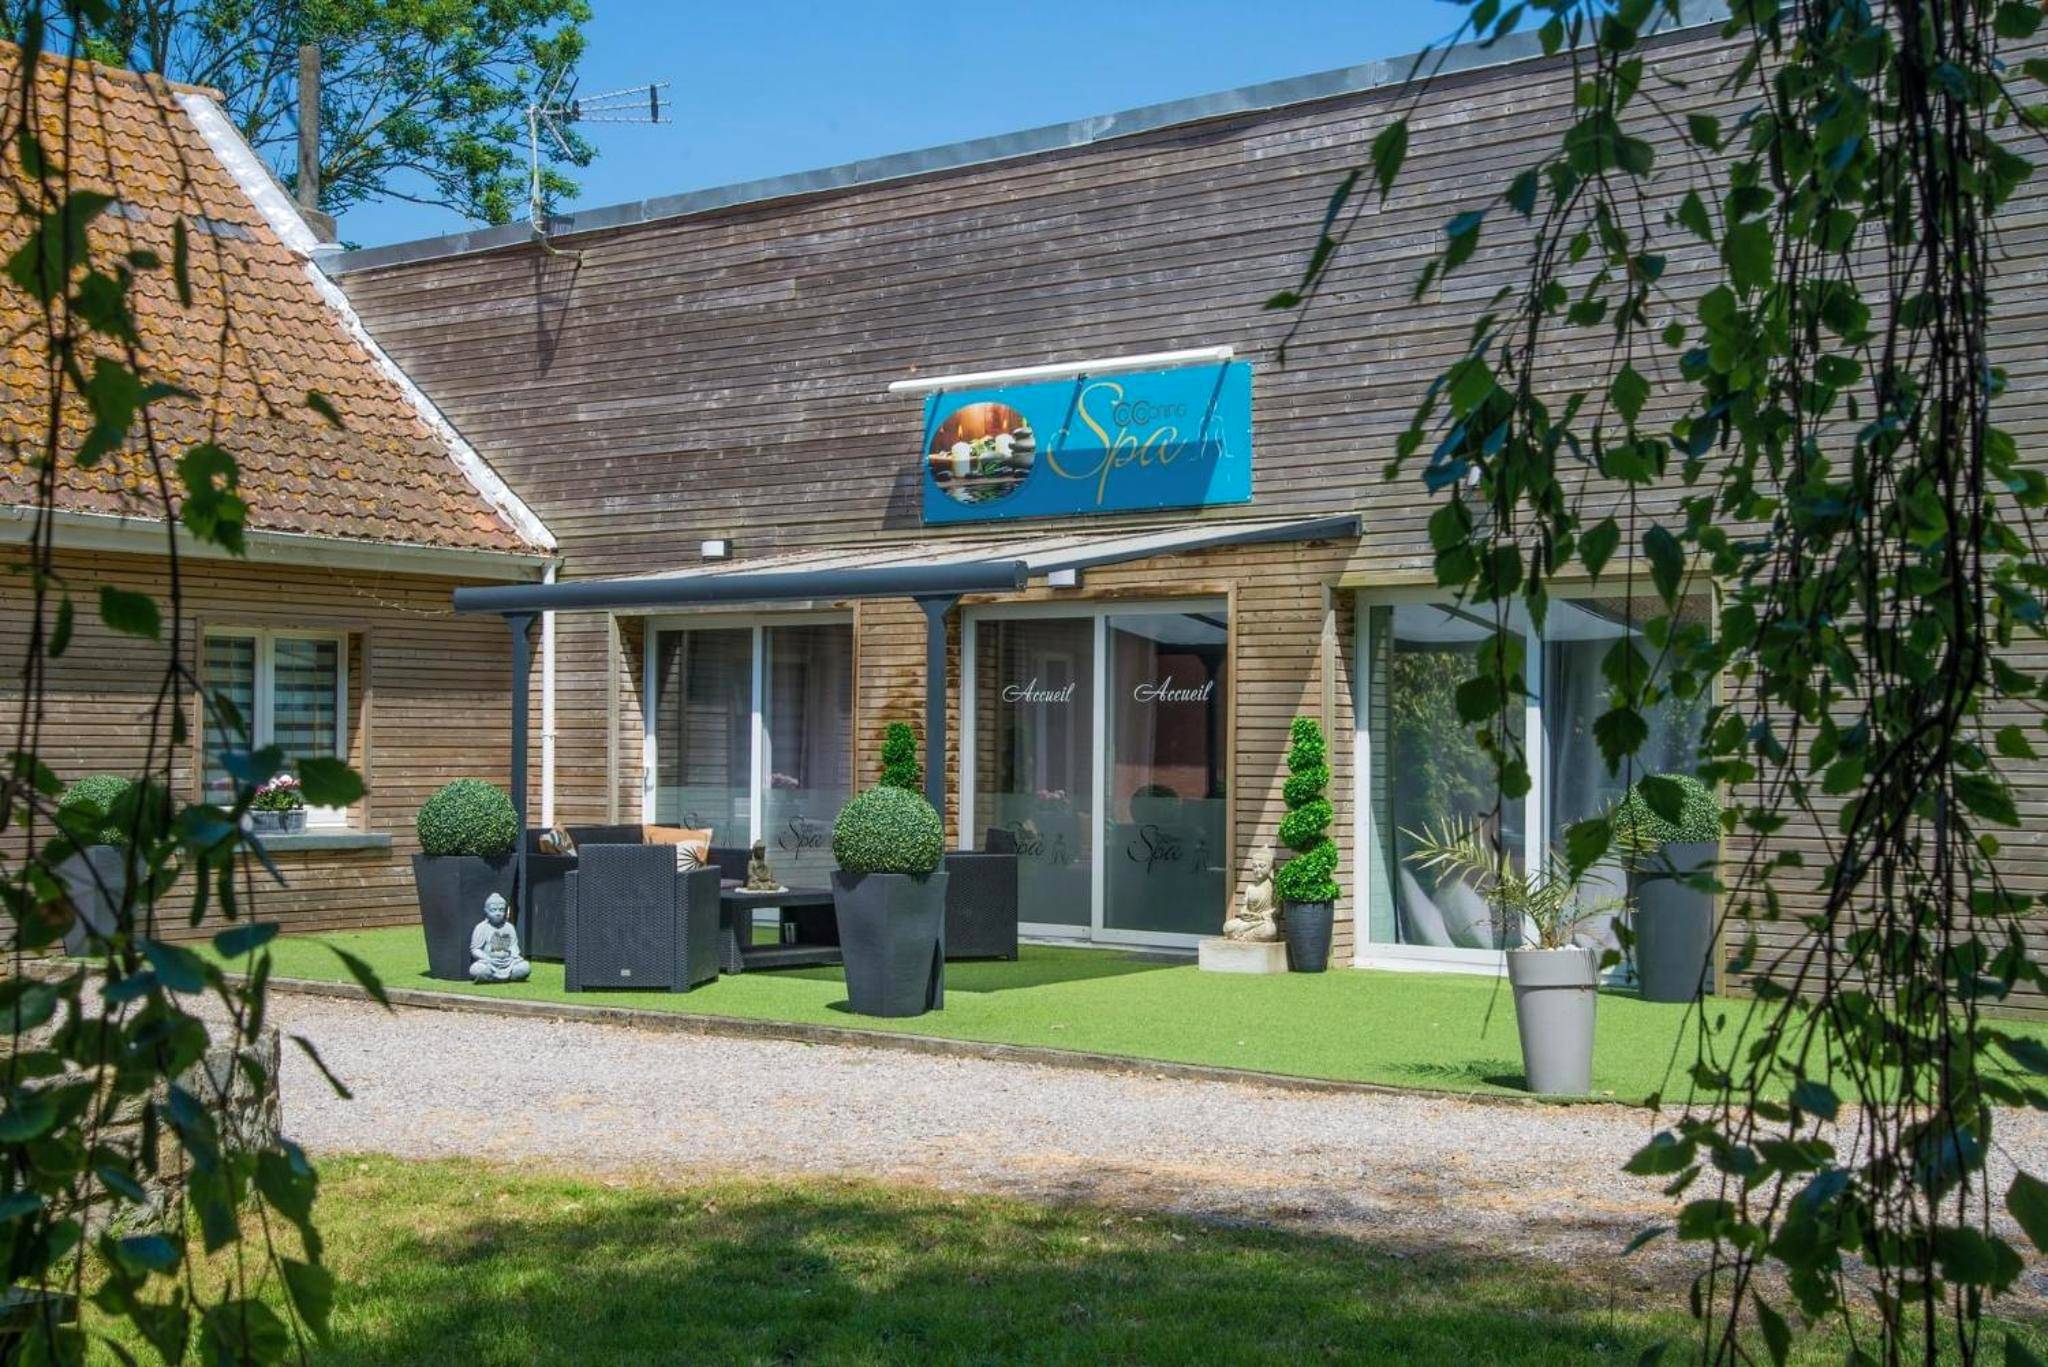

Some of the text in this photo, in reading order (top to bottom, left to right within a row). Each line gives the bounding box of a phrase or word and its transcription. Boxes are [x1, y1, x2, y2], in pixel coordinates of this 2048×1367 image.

[1047, 382, 1188, 505] Spa
[1002, 677, 1076, 703] Accueil
[1134, 675, 1214, 703] Accueil
[777, 815, 824, 865] Spa
[1126, 824, 1183, 875] Spa
